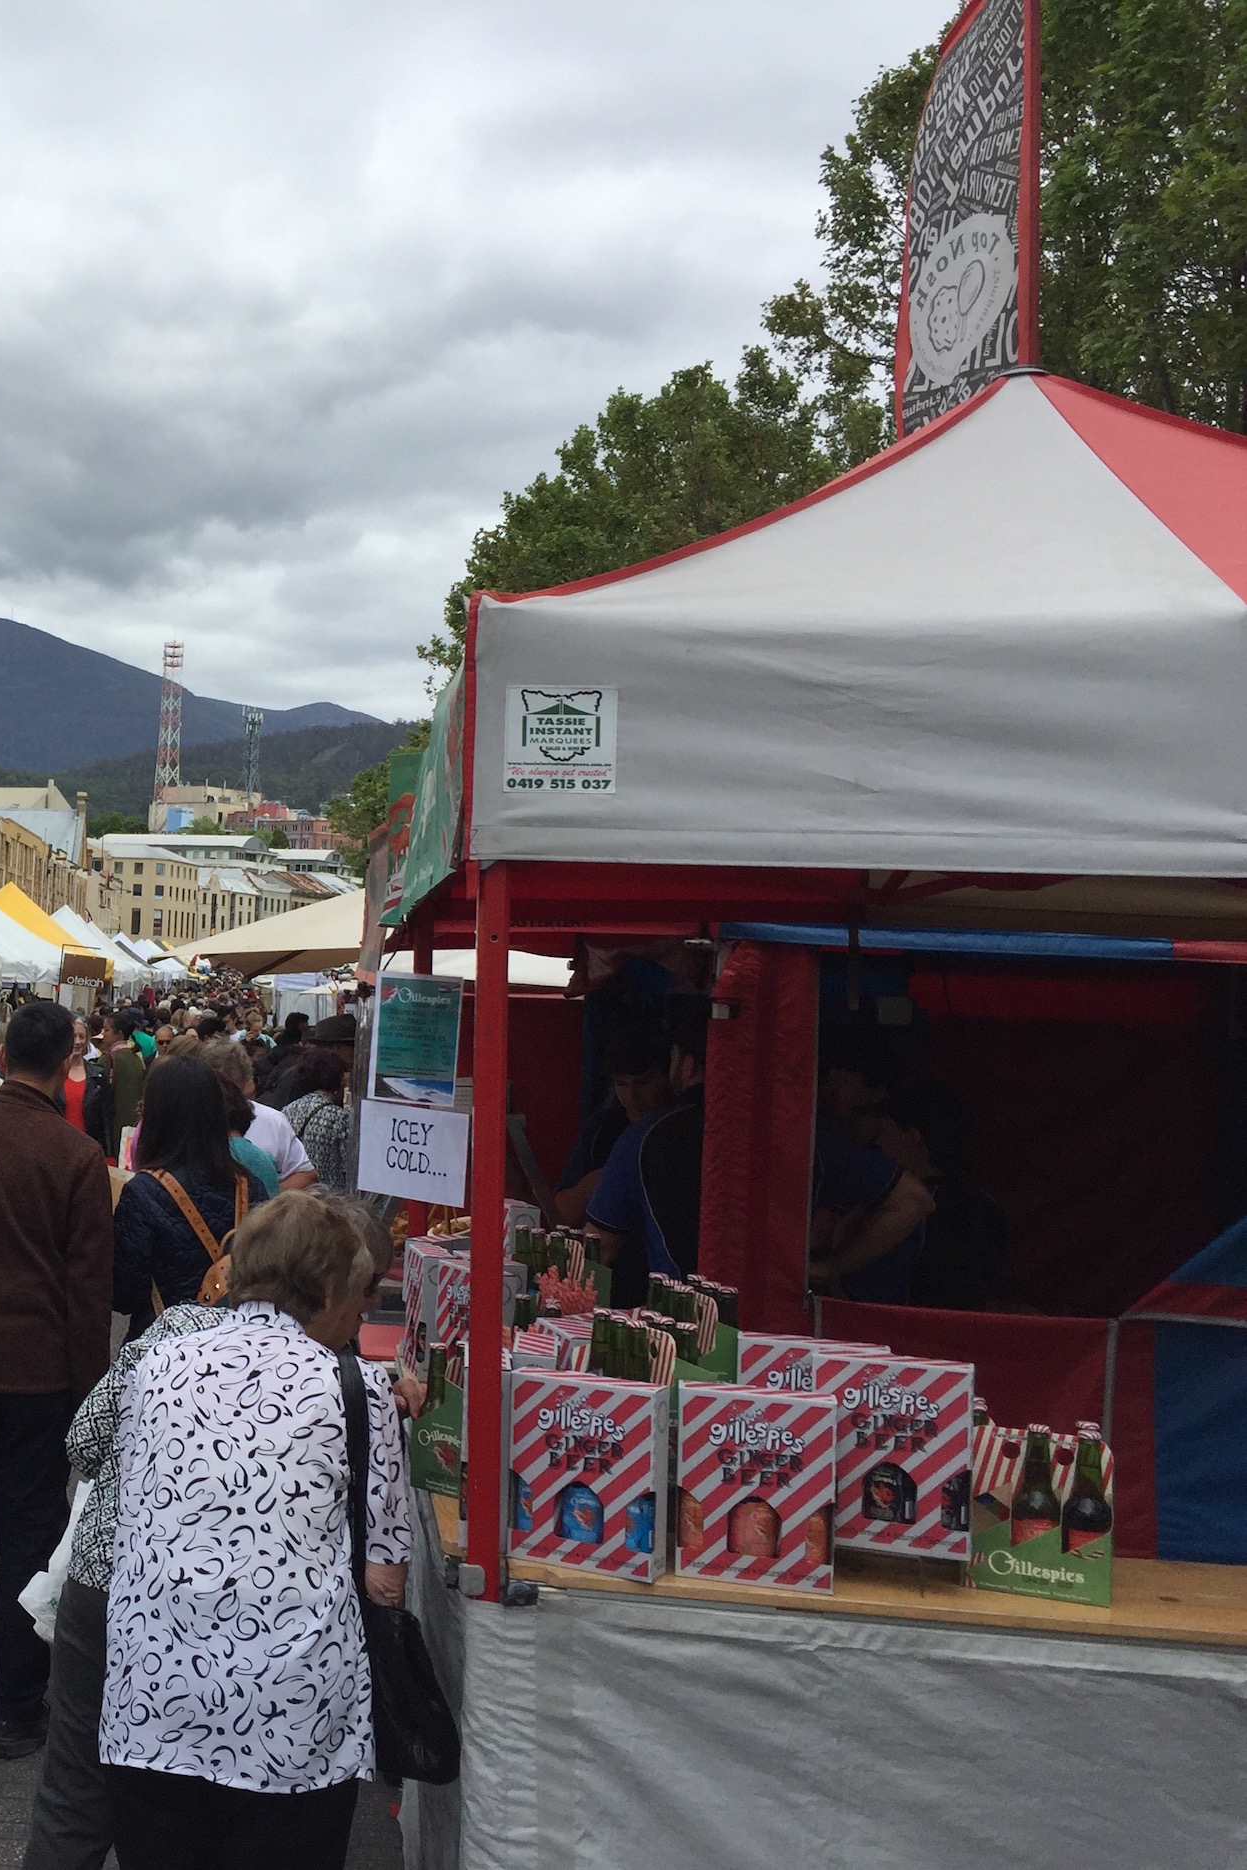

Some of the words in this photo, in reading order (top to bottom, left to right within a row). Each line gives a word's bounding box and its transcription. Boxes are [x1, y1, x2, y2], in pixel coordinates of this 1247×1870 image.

[530, 727, 593, 735] INSTANT
[537, 718, 585, 726] TASSIE
[530, 737, 592, 745] MARQUEES
[507, 778, 544, 789] 0419
[550, 779, 576, 789] 515
[581, 780, 612, 789] 037
[528, 768, 559, 778] always
[562, 769, 576, 778] get
[67, 975, 104, 988] otekah
[391, 1118, 434, 1146] ICEY
[843, 1382, 940, 1419] gillespies
[537, 1404, 625, 1442] gillespies
[851, 1412, 938, 1437] GINGER
[545, 1433, 624, 1459] GINGER
[709, 1418, 805, 1454] gillespies
[855, 1432, 928, 1453] BEER
[548, 1451, 613, 1475] BEER
[718, 1448, 802, 1473] GINGER
[721, 1467, 793, 1488] BEER
[988, 1550, 1085, 1583] Gillespies
